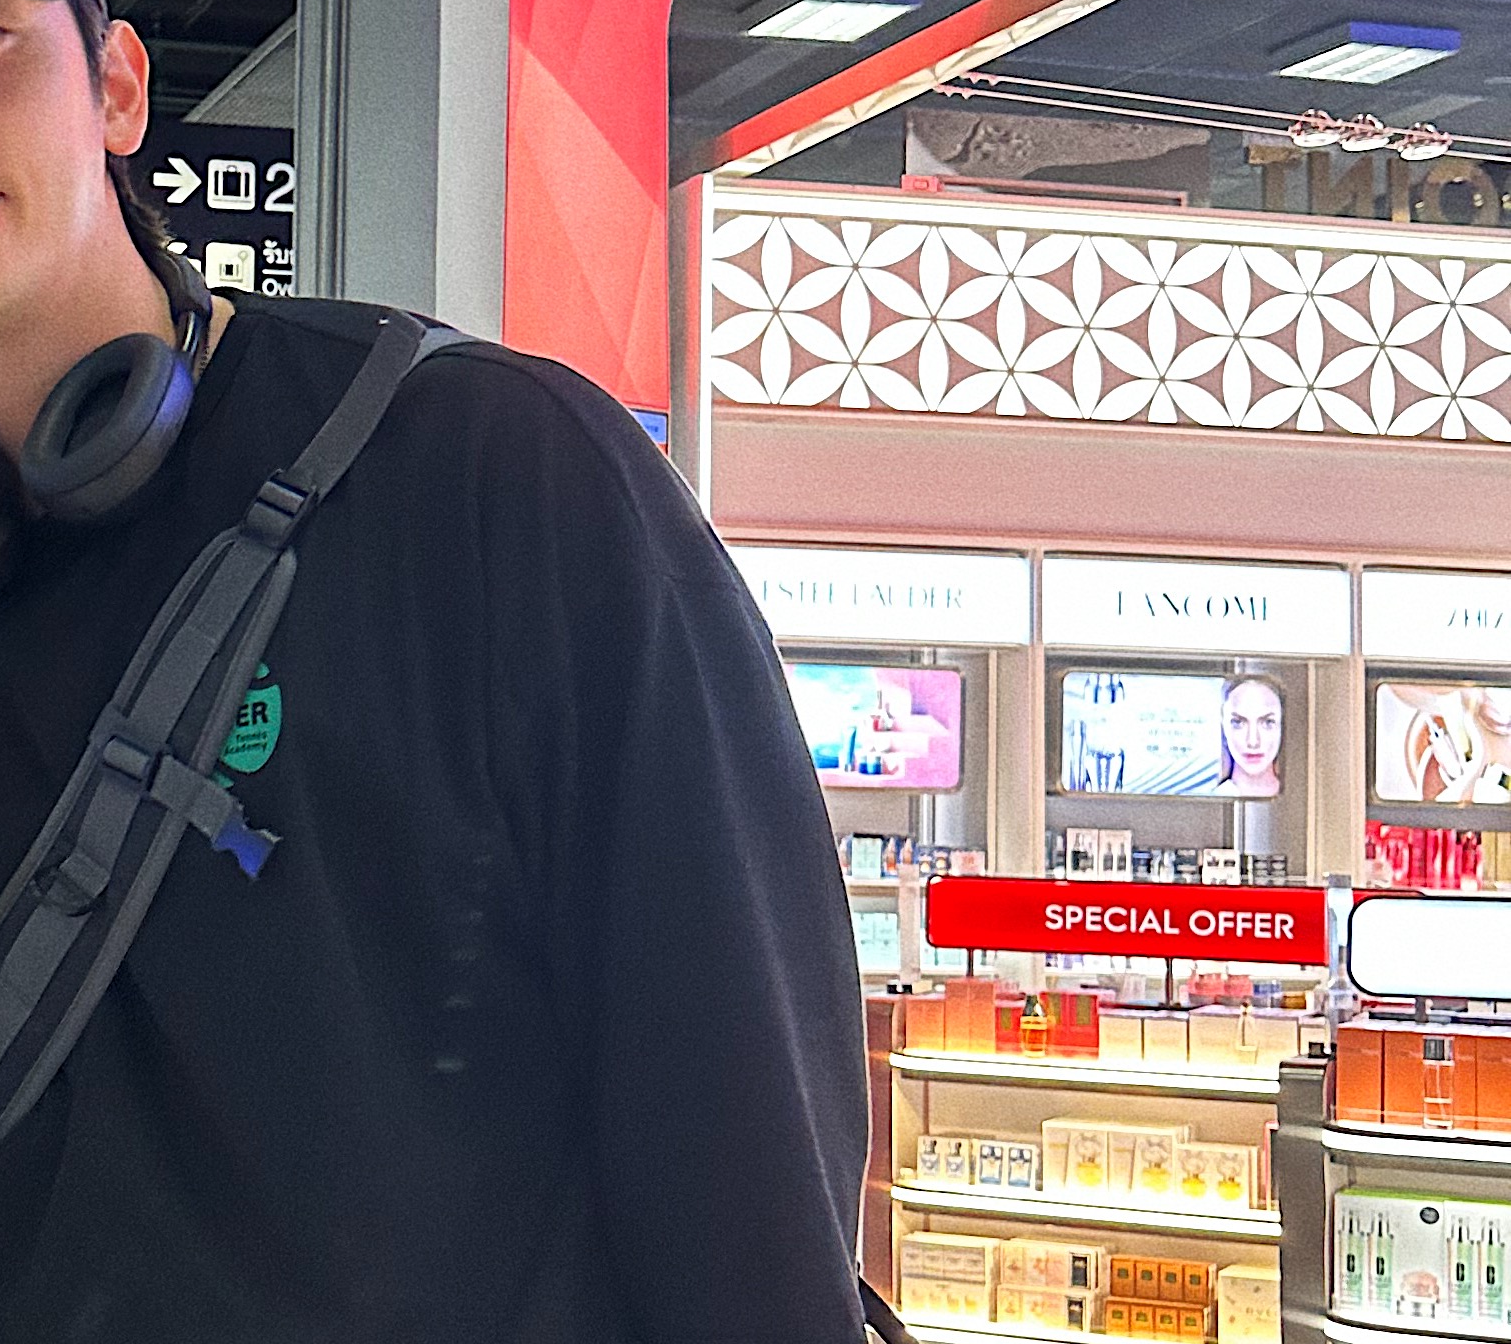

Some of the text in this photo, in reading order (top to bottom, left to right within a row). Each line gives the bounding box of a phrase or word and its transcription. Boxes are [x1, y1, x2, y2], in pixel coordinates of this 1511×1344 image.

[236, 700, 268, 727] ER
[1044, 903, 1295, 940] SPECIAL OFFER
